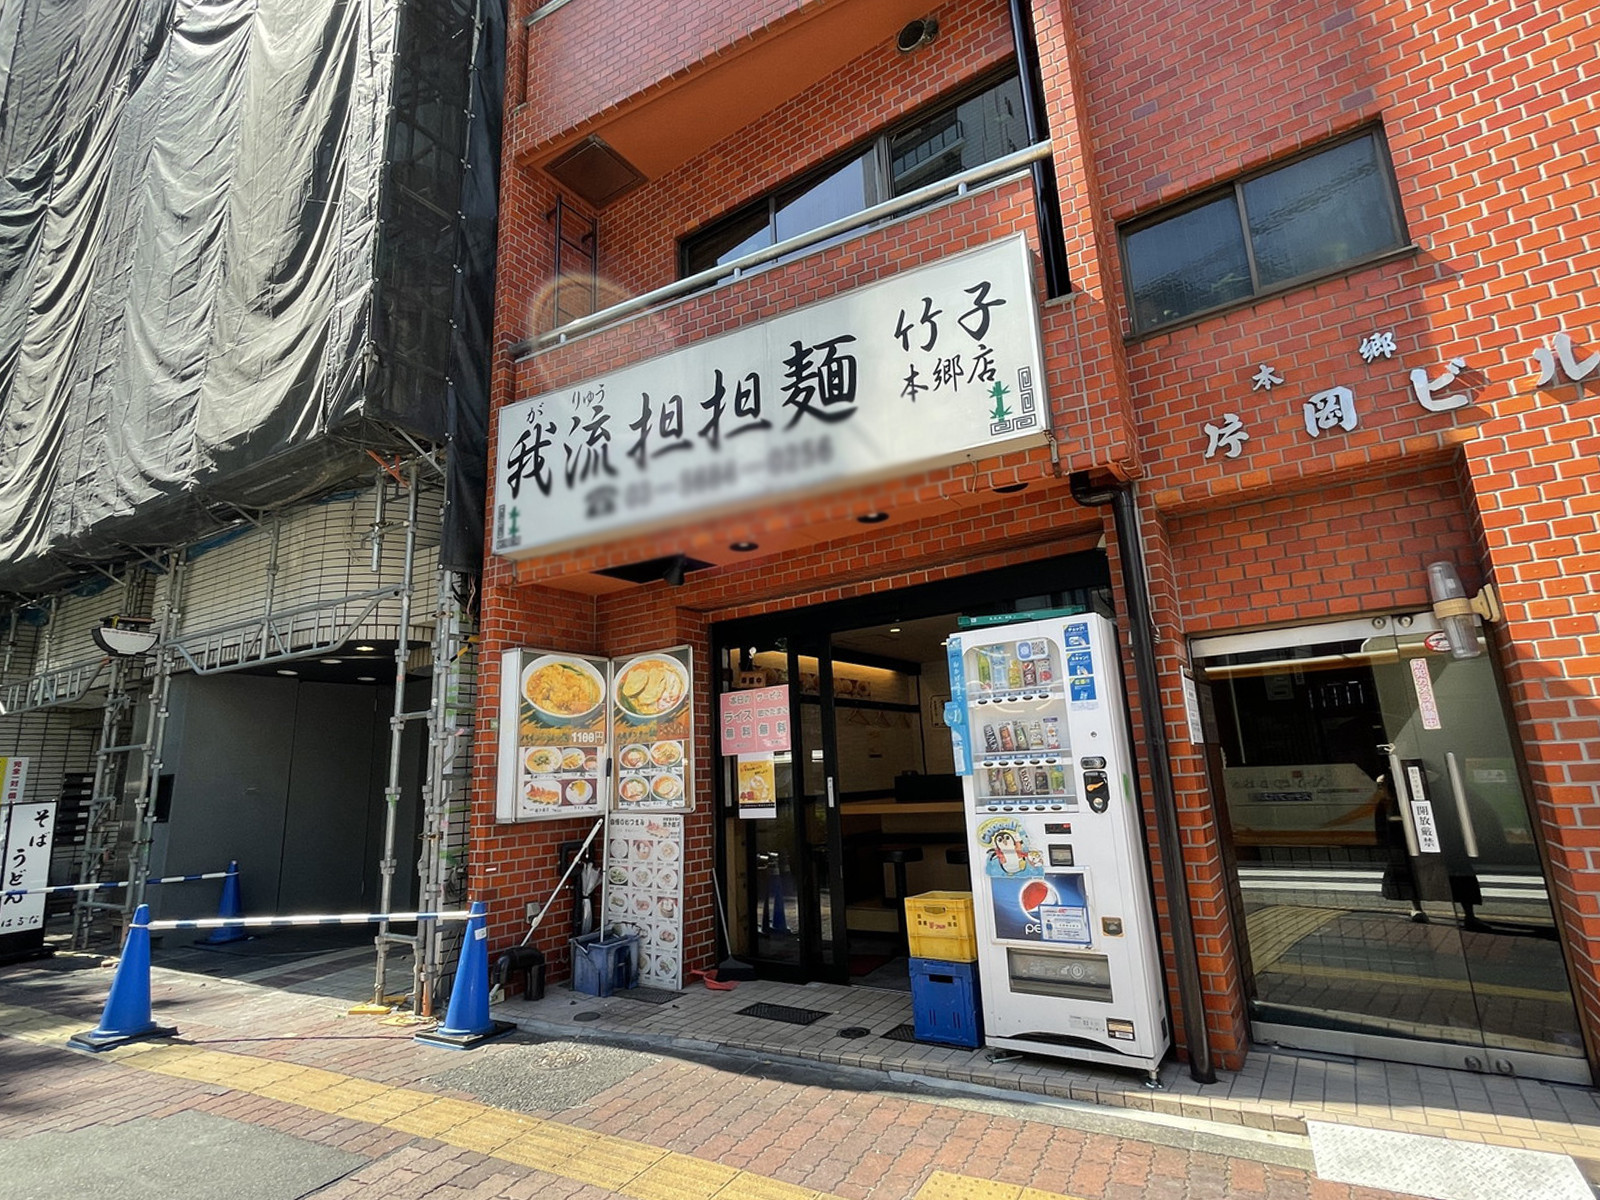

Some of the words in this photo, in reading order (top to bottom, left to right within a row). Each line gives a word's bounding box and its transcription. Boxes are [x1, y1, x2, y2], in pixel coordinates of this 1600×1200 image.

[894, 281, 1007, 353] 竹子
[899, 344, 999, 403] 本郷店
[1252, 332, 1396, 391] 本郷
[528, 406, 544, 424] が
[571, 383, 607, 409] りゅう
[1203, 333, 1600, 458] 片岡ビル
[507, 335, 858, 500] 我流担担麺
[724, 710, 753, 724] ライス
[7, 760, 23, 801] 完全一対一個
[1021, 770, 1032, 793] BOSS
[28, 808, 51, 848] そば
[1416, 806, 1435, 848] 開放厳禁
[4, 848, 28, 904] うどん
